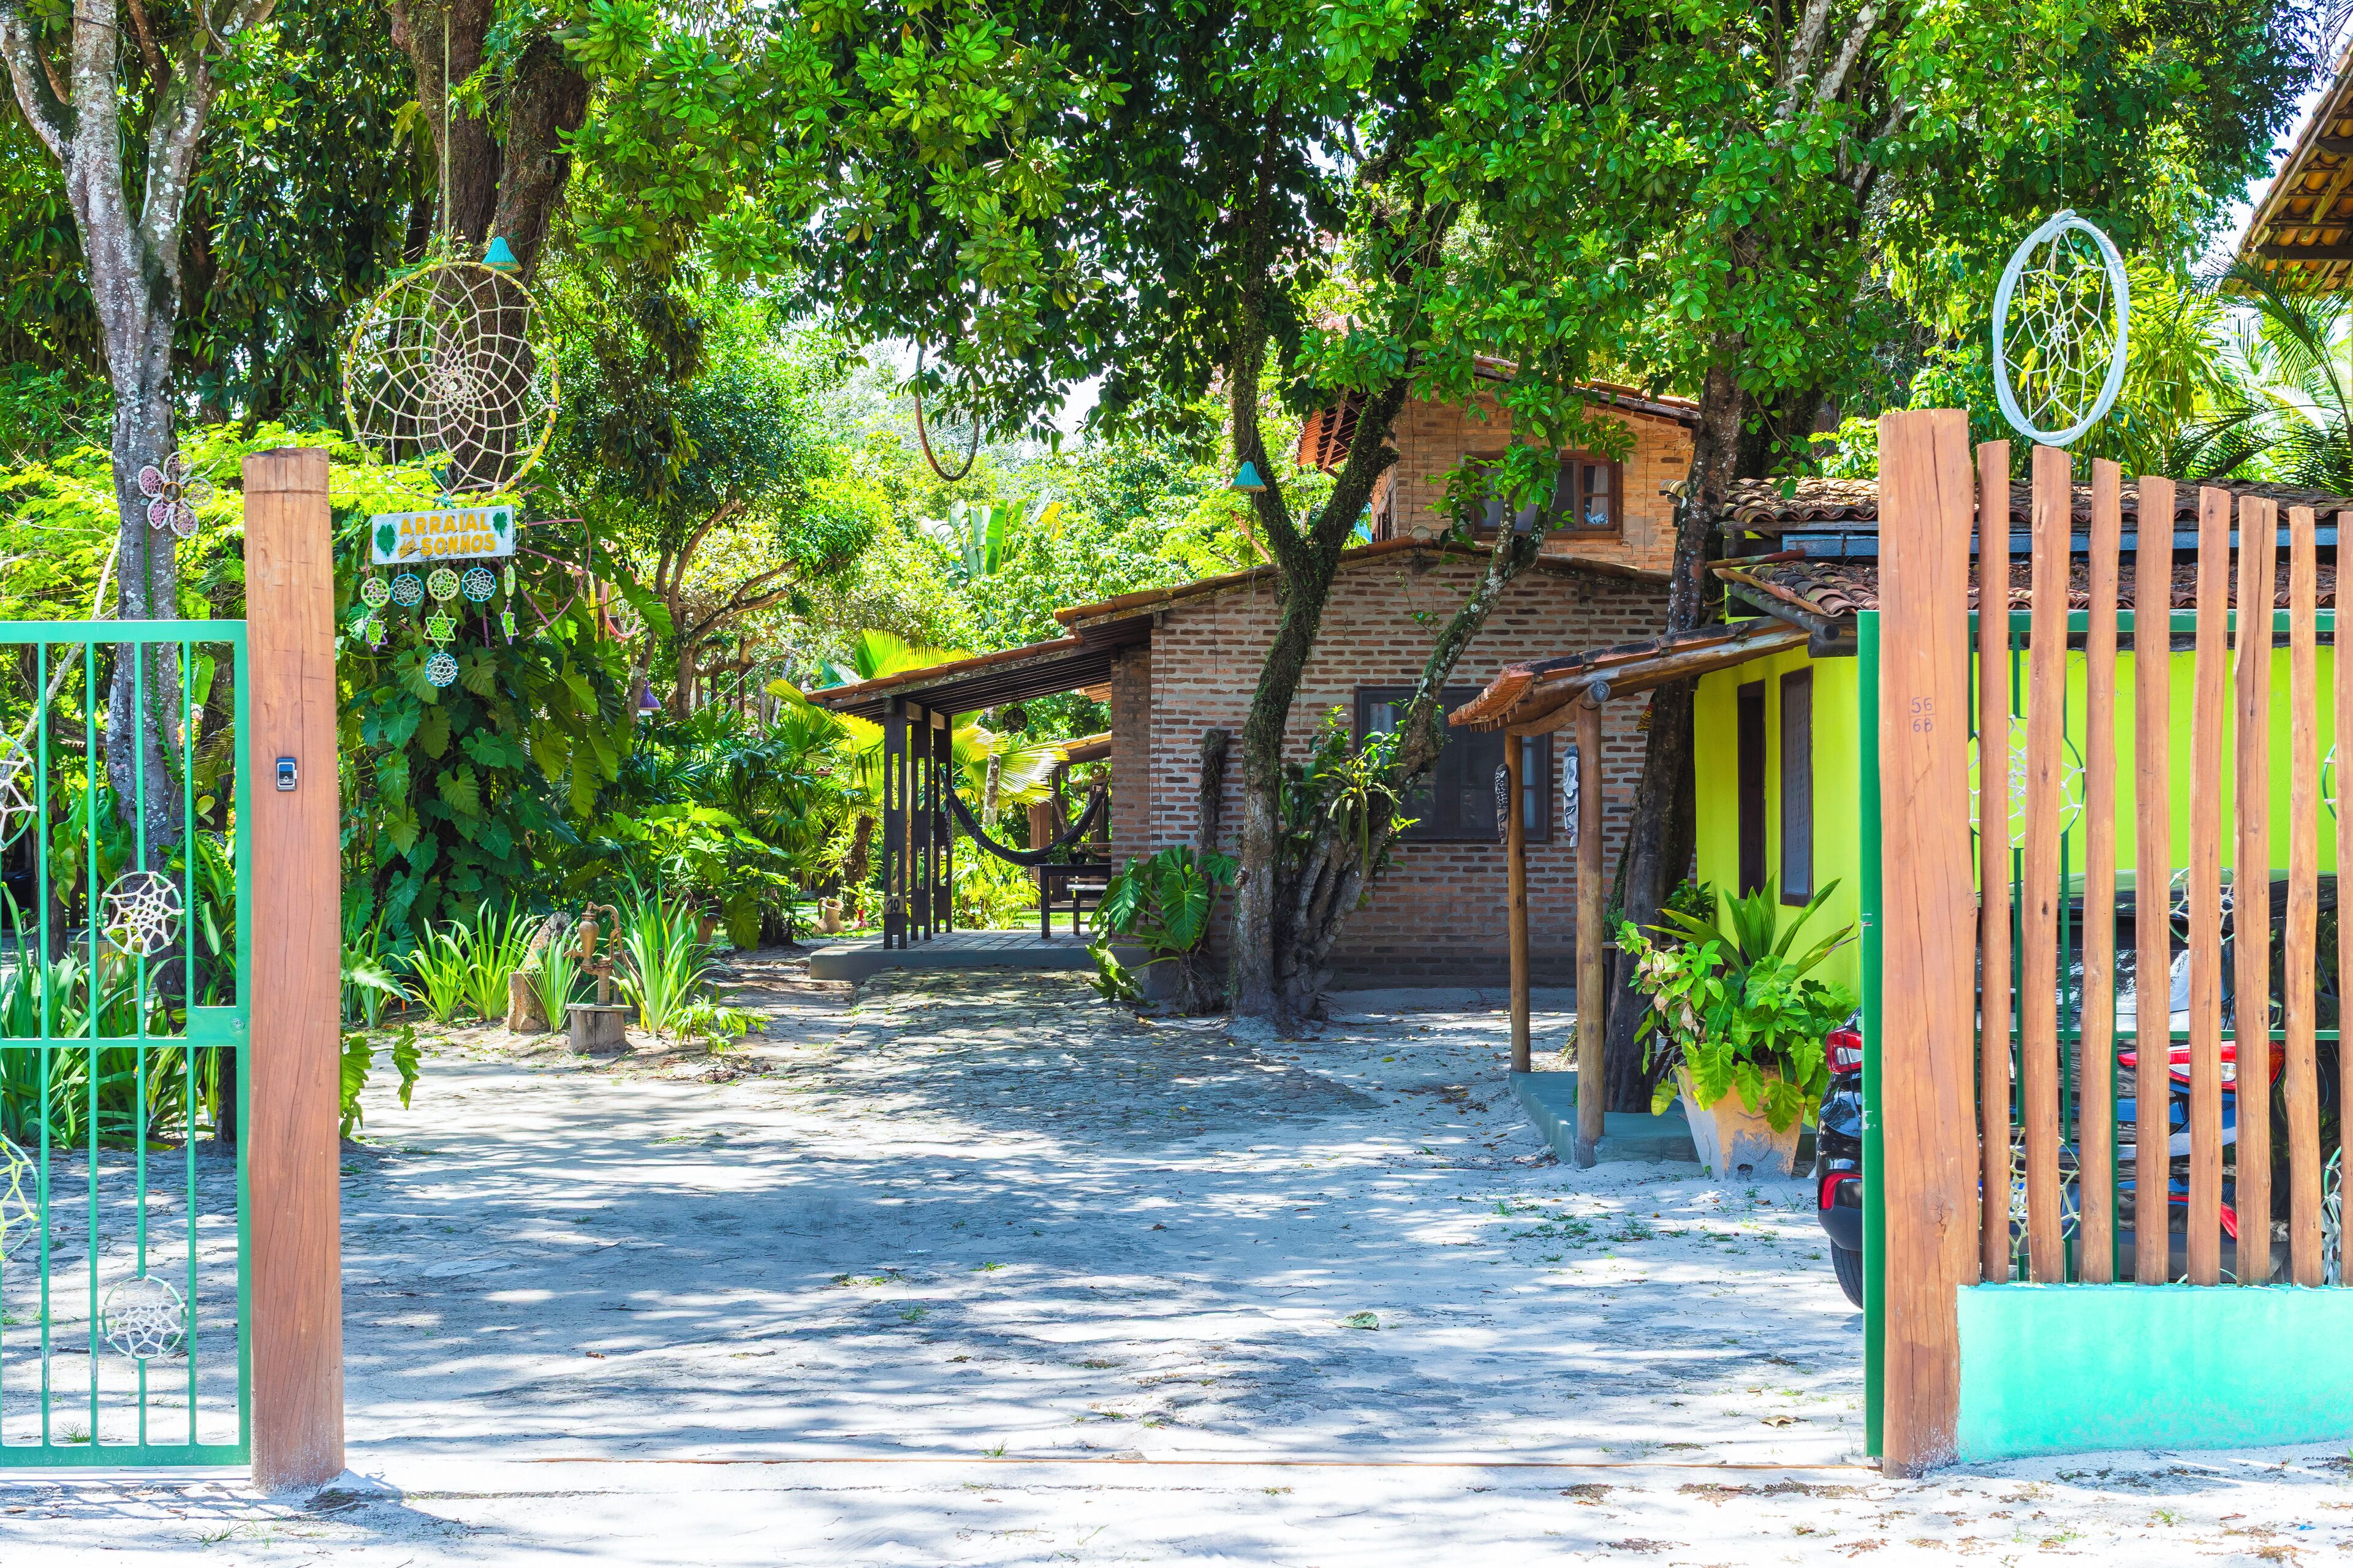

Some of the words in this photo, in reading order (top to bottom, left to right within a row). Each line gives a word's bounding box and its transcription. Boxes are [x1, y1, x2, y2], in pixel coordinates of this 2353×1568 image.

[399, 513, 491, 537] ARRAIAL
[420, 534, 496, 557] SONHOS
[1911, 697, 1933, 713] 56
[887, 898, 900, 912] 10
